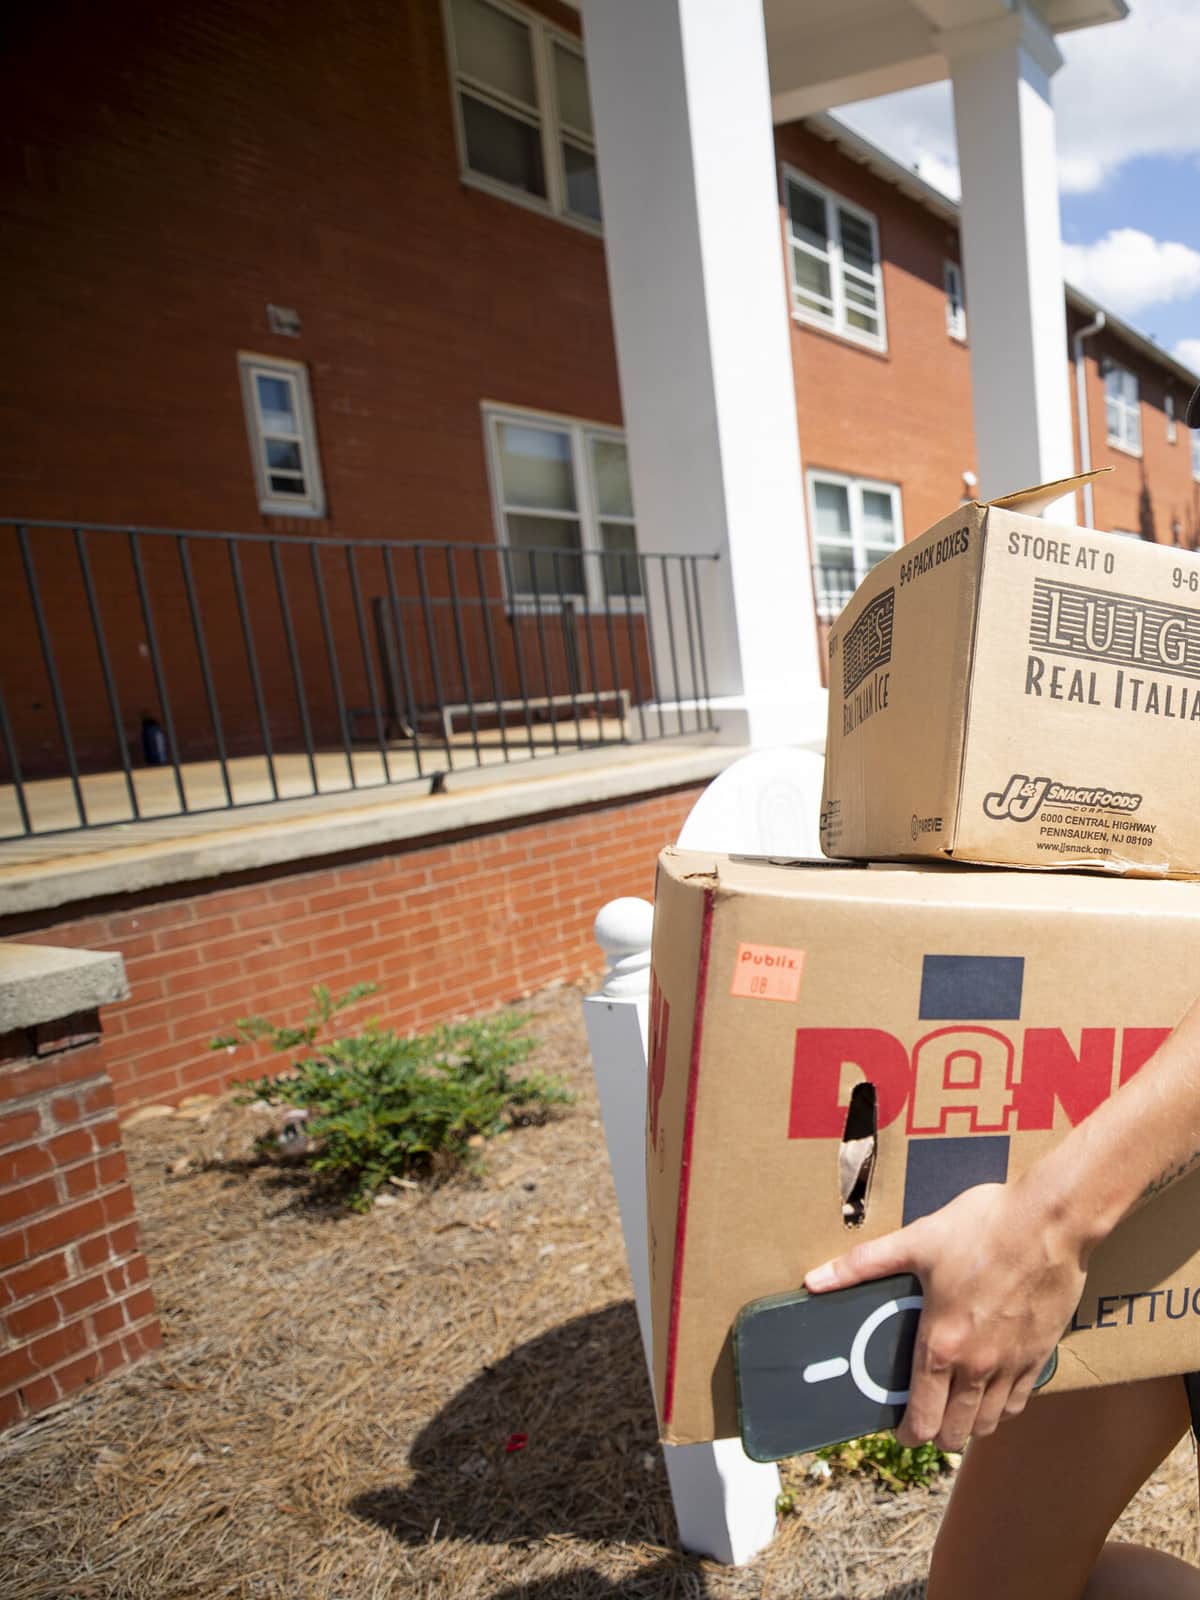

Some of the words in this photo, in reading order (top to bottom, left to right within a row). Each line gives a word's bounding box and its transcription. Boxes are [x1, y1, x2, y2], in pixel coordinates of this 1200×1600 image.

[913, 544, 935, 579] PACK
[936, 526, 969, 566] BOXES
[1007, 531, 1071, 566] STORE
[1075, 546, 1100, 571] AT
[1103, 552, 1115, 574] 0
[1172, 567, 1198, 592] 9-6
[874, 672, 890, 713] ICE
[1024, 655, 1101, 706] REAL
[1040, 813, 1063, 824] 6000
[1065, 816, 1110, 829] CENTRAL
[1112, 821, 1157, 834] HIGHWAY
[1040, 826, 1109, 843] PENNSAUKEN,
[1111, 834, 1125, 844] NJ
[1126, 836, 1153, 847] 08109
[1036, 842, 1112, 856] www.jjsnack.com
